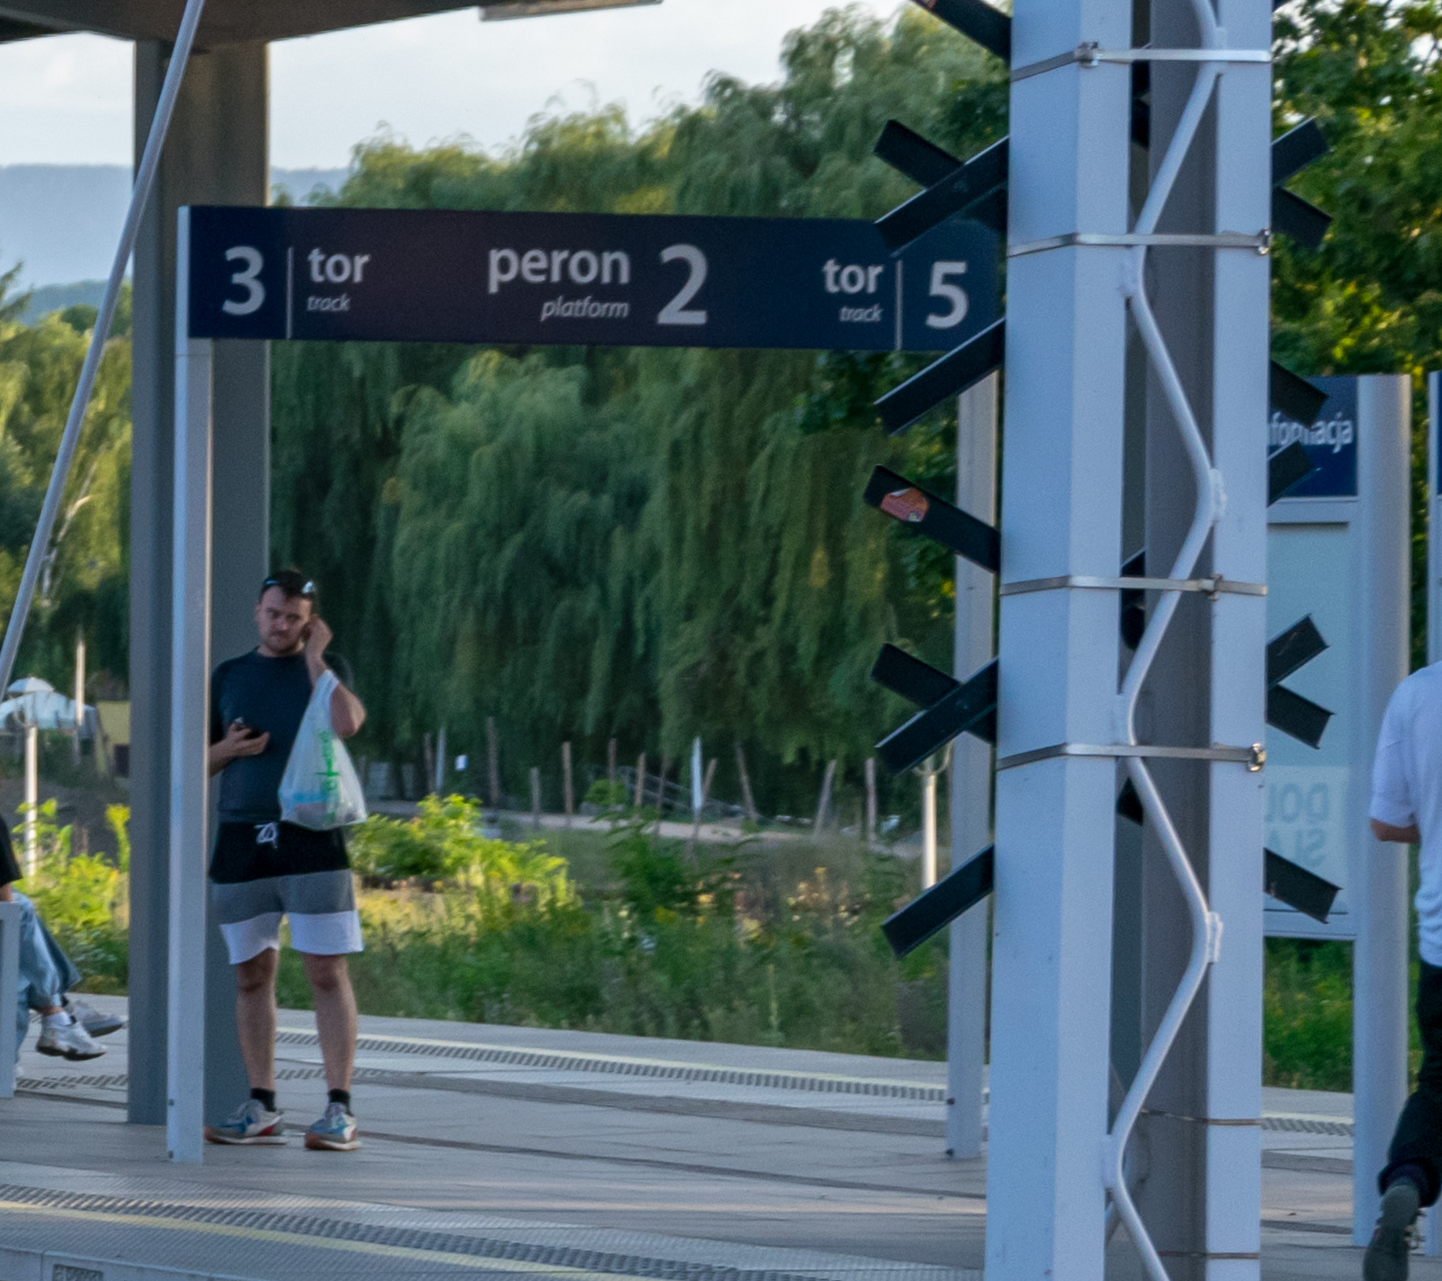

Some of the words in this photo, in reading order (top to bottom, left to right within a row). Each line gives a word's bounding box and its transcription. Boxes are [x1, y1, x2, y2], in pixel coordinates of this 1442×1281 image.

[223, 245, 266, 315] 3
[307, 248, 372, 284] tor
[306, 293, 351, 312] track
[488, 248, 631, 295] peron
[657, 244, 708, 325] 2
[822, 258, 885, 295] tor
[925, 259, 969, 330] 5
[540, 295, 630, 322] platform
[838, 302, 883, 323] track
